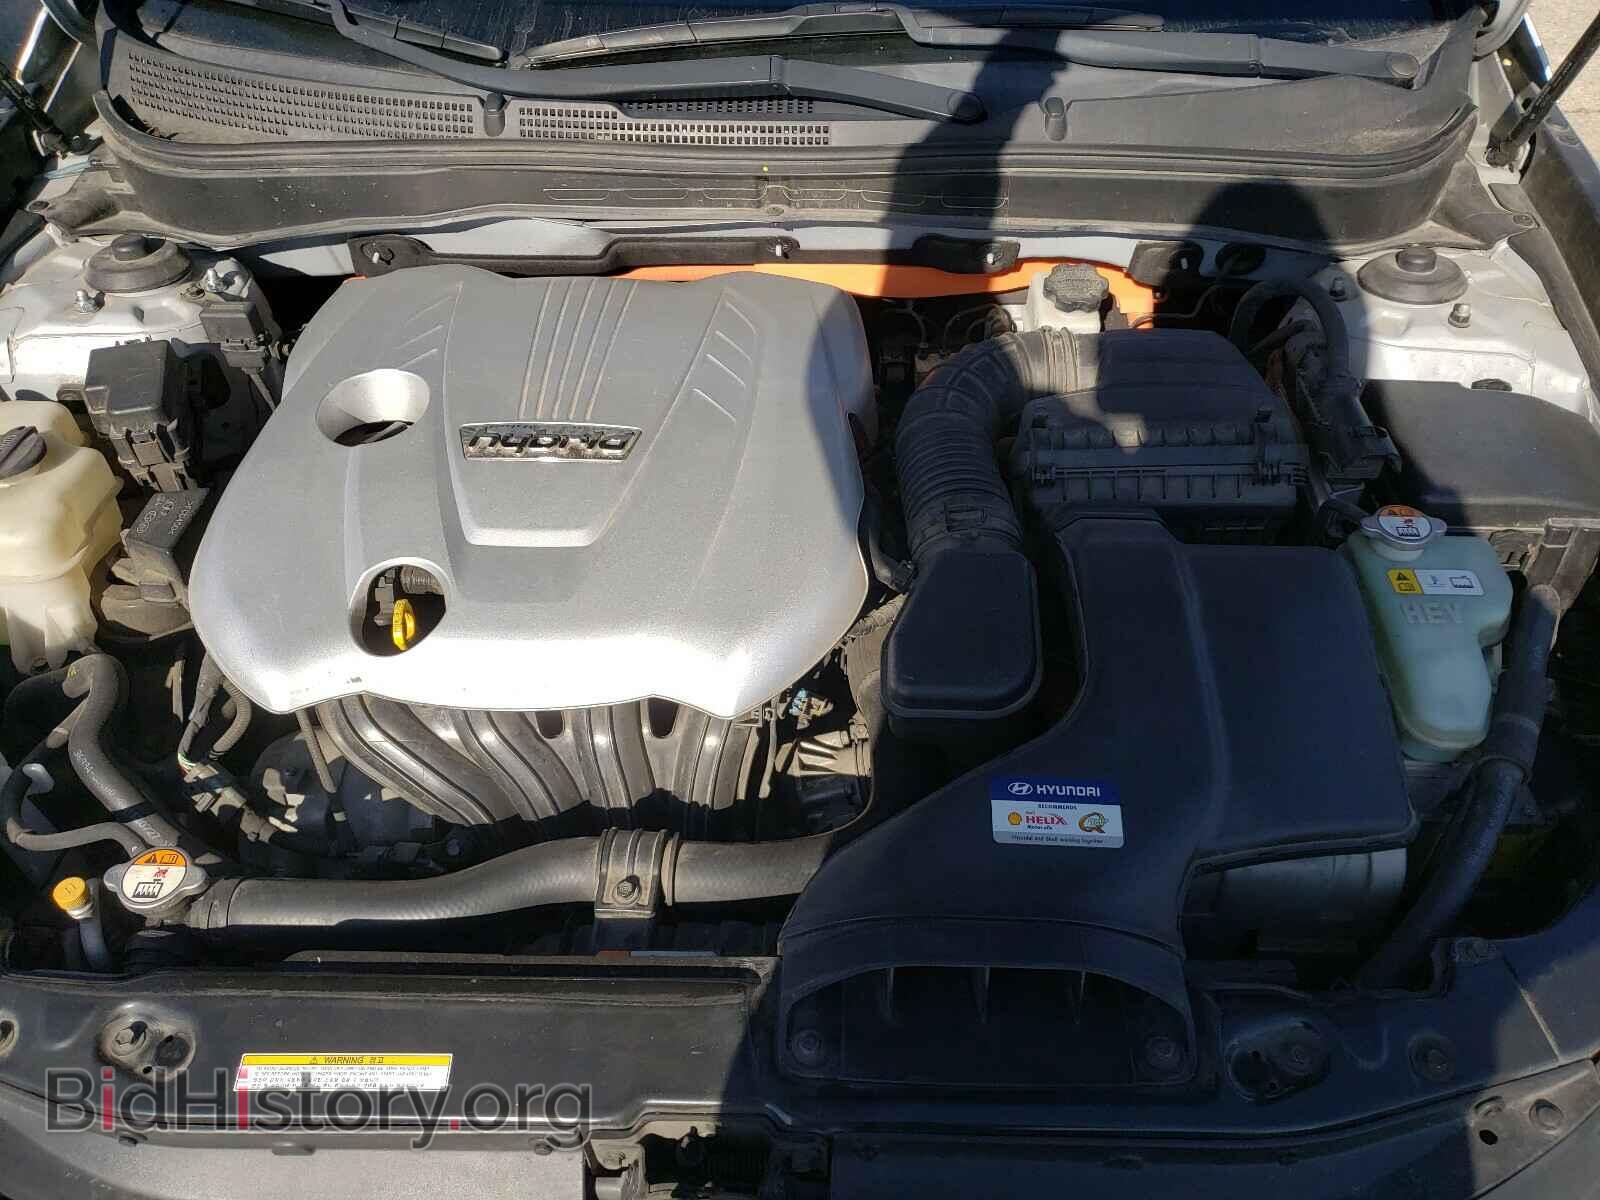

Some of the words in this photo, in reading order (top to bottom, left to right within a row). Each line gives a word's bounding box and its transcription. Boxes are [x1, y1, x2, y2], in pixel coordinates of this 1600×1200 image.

[1400, 600, 1465, 624] HEV
[1036, 784, 1101, 797] HYUNDAI
[1025, 815, 1069, 825] HELIX
[324, 1056, 365, 1064] WARNING
